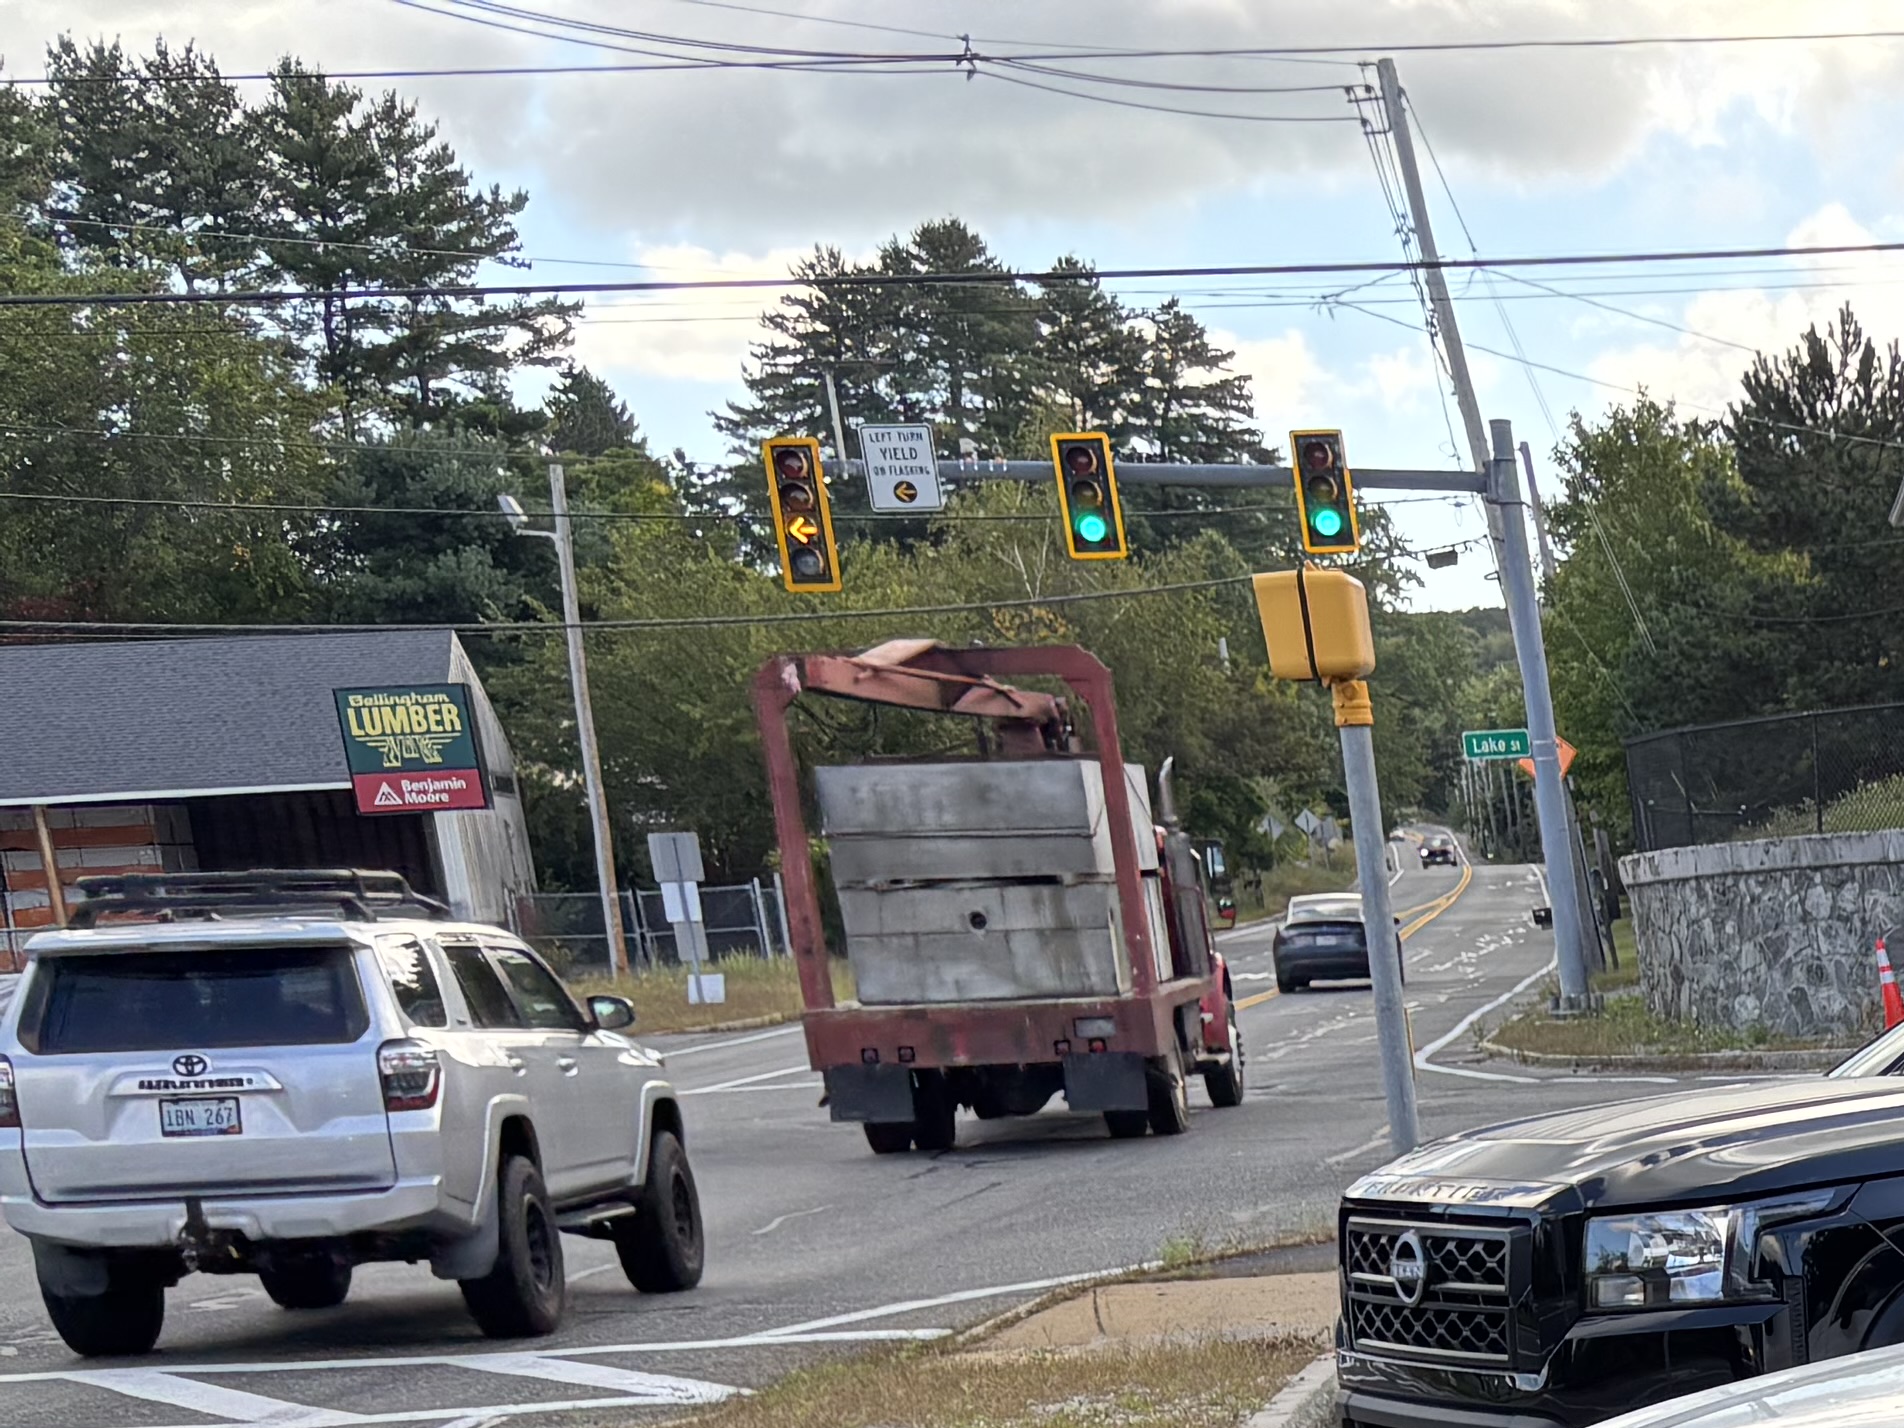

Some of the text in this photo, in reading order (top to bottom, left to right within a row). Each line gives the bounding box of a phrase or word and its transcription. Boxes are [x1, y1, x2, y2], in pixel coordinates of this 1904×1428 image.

[869, 431, 923, 443] LEFT TURN
[879, 447, 918, 460] YIELD
[348, 692, 450, 707] Bellingham
[347, 703, 462, 736] LUMBER
[1472, 736, 1506, 753] Lake
[401, 777, 466, 794] Benjamin
[405, 791, 449, 804] Moore
[204, 1107, 232, 1126] 267
